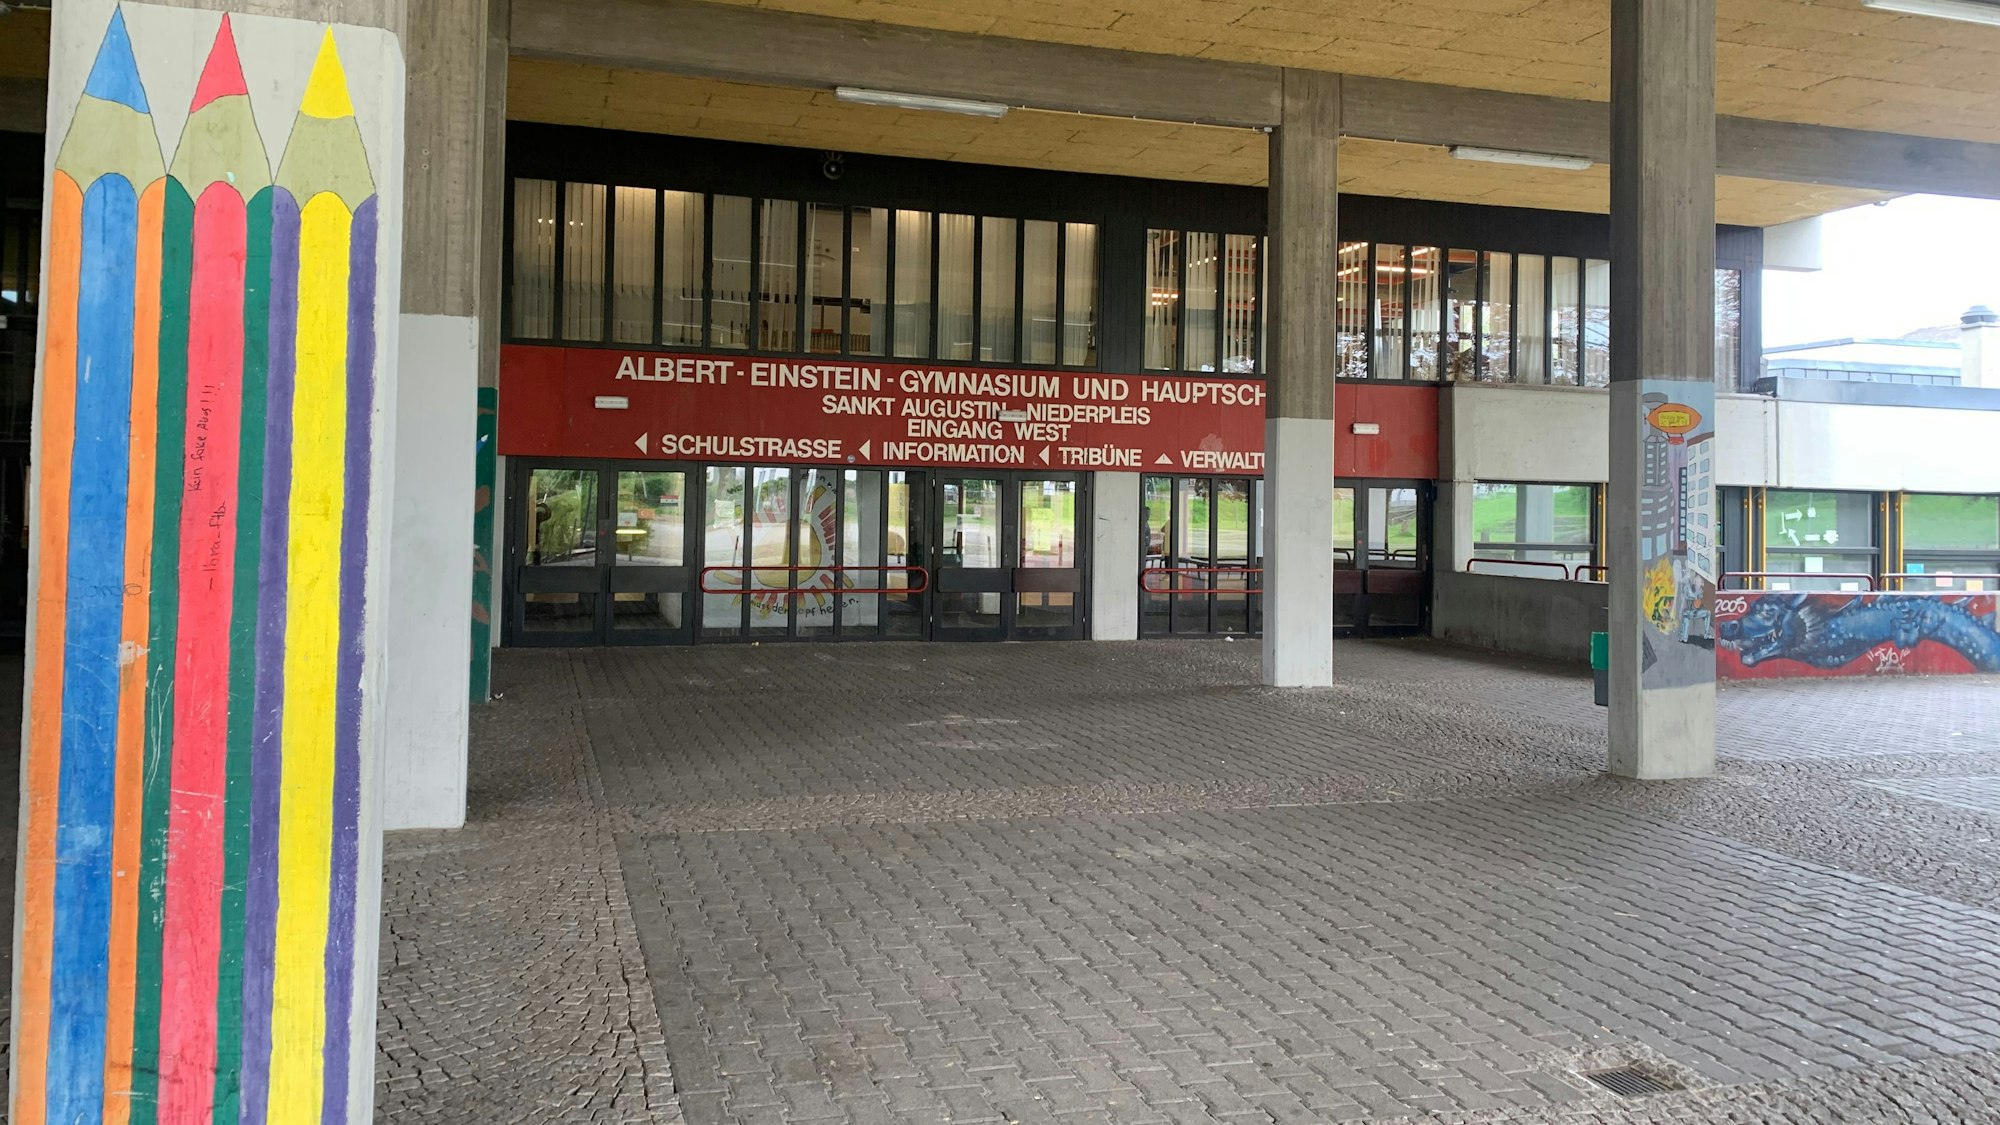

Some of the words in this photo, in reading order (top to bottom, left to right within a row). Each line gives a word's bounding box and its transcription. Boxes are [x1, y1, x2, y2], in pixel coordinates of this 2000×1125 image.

[1073, 377, 1130, 401] UND
[821, 394, 896, 416] SANKT
[907, 418, 1003, 441] EINGANG
[1013, 422, 1071, 442] WEST
[661, 433, 842, 459] SCHULSTRASSE
[882, 441, 1025, 464] INFORMATION
[1057, 443, 1143, 467] TRIBÜNE
[1715, 596, 1747, 613] 2005
